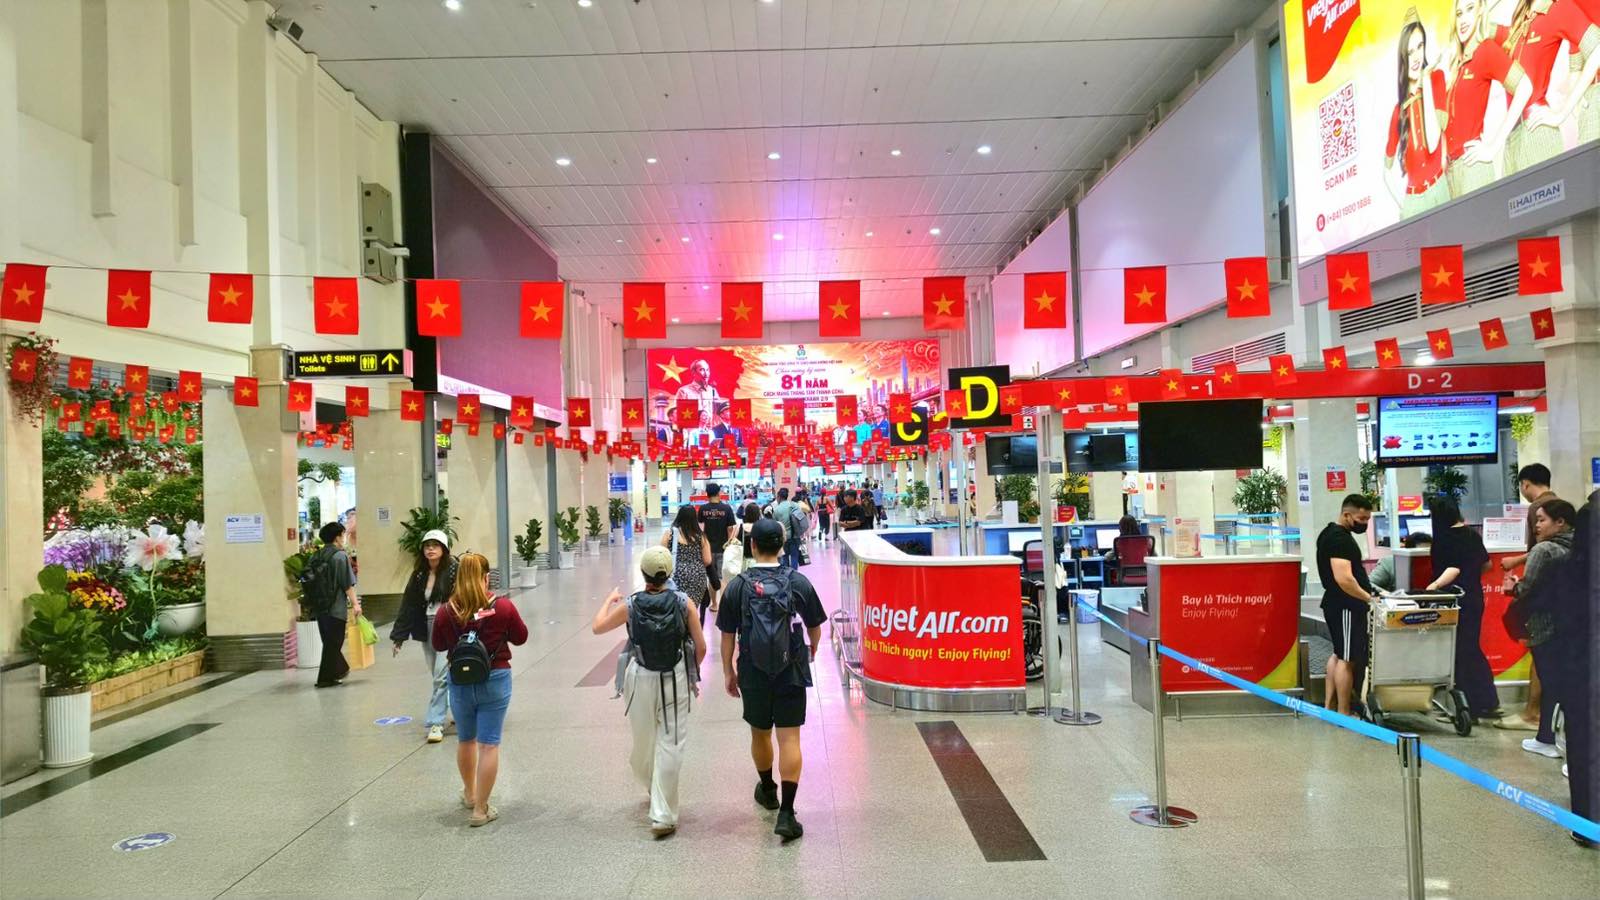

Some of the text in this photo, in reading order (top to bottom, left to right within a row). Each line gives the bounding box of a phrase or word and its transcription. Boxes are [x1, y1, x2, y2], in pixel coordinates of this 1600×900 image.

[1325, 164, 1357, 190] SCAN ME
[299, 354, 356, 364] NHÀ VỆ SINH
[299, 365, 326, 373] Toilets
[781, 374, 802, 390] 81
[960, 375, 999, 420] D
[896, 411, 922, 442] C
[1182, 595, 1201, 607] Bay
[1204, 594, 1213, 605] là
[1245, 593, 1272, 606] ngay!
[1182, 607, 1239, 619] Enjoy Flying!
[903, 648, 933, 660] ngay!
[938, 648, 970, 661] Enjoy
[972, 647, 1011, 661] Flying!
[1497, 781, 1522, 803] ACV
